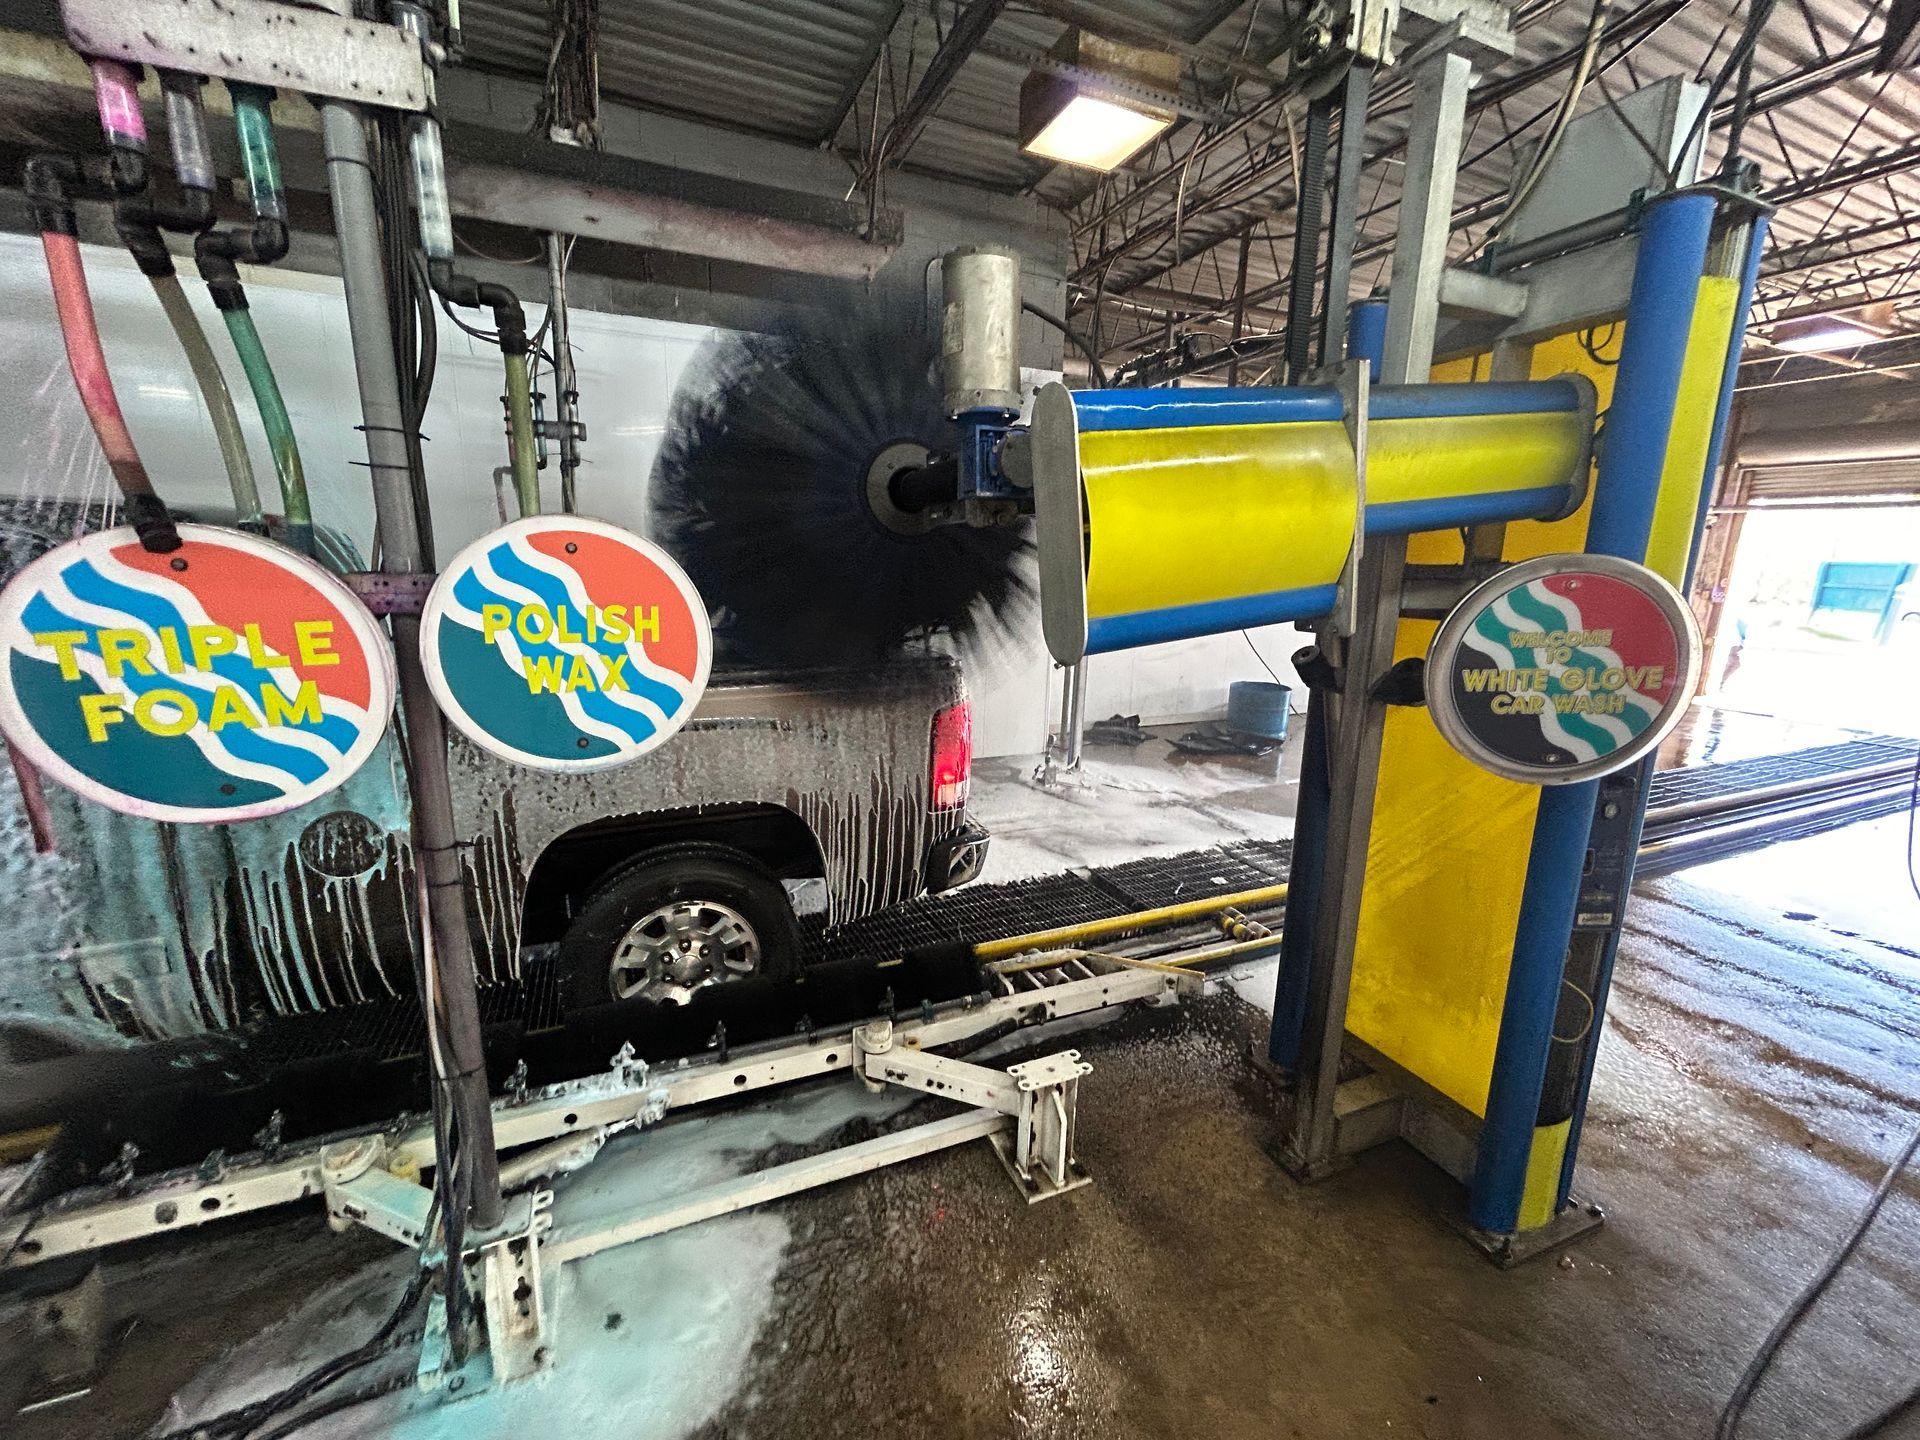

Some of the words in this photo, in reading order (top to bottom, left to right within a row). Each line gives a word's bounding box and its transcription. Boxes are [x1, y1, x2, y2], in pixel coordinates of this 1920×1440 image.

[482, 603, 660, 644] POLISH
[33, 620, 340, 681] TRIPLE
[1511, 631, 1613, 648] WELCOME
[1546, 648, 1571, 664] TO
[522, 655, 630, 694] WAX
[1463, 669, 1548, 691] WHITE
[1562, 667, 1665, 689] GLOVE
[79, 680, 323, 743] FOAM
[1491, 696, 1544, 714] CAR
[1555, 695, 1625, 713] WASH
